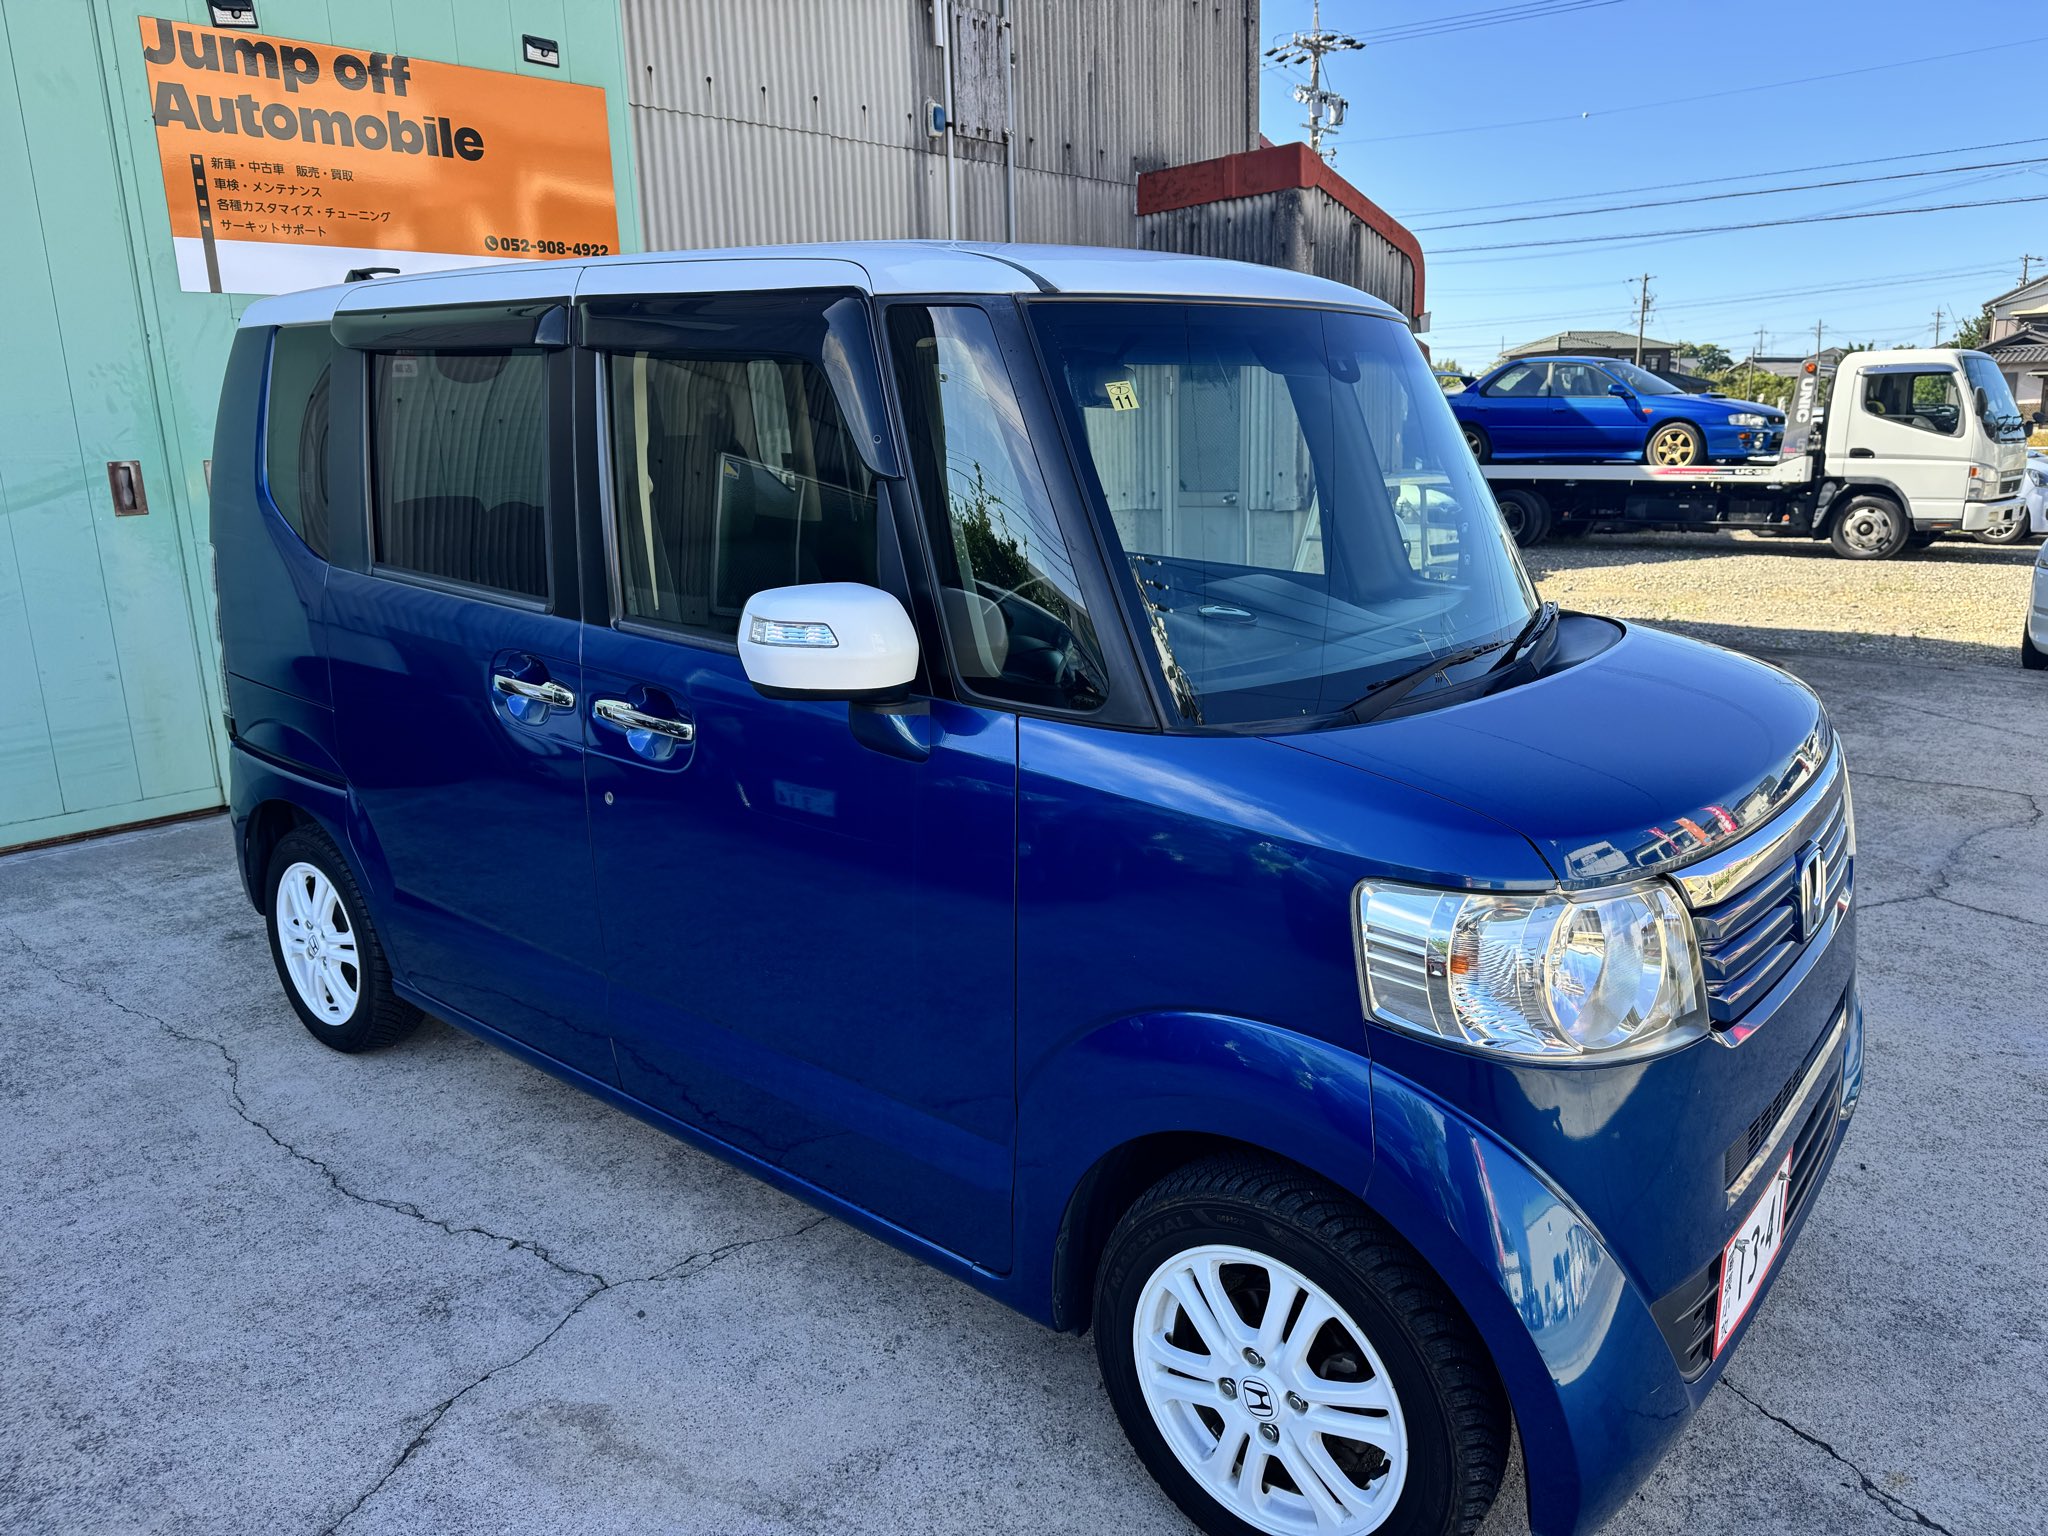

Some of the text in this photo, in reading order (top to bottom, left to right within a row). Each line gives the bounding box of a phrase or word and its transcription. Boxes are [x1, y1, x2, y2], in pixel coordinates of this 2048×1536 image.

[144, 18, 411, 97] Jump off
[155, 81, 485, 162] Automobile
[211, 157, 354, 182] 新車・中古車 販売・買取
[214, 178, 322, 197] 車検・メンテナンス
[216, 198, 391, 222] 各種カスタマイズ・チューニング
[220, 219, 326, 237] サーキットサポート
[500, 237, 609, 257] 052-908-4922
[1115, 394, 1133, 409] 11
[1796, 377, 1814, 423] UNIC
